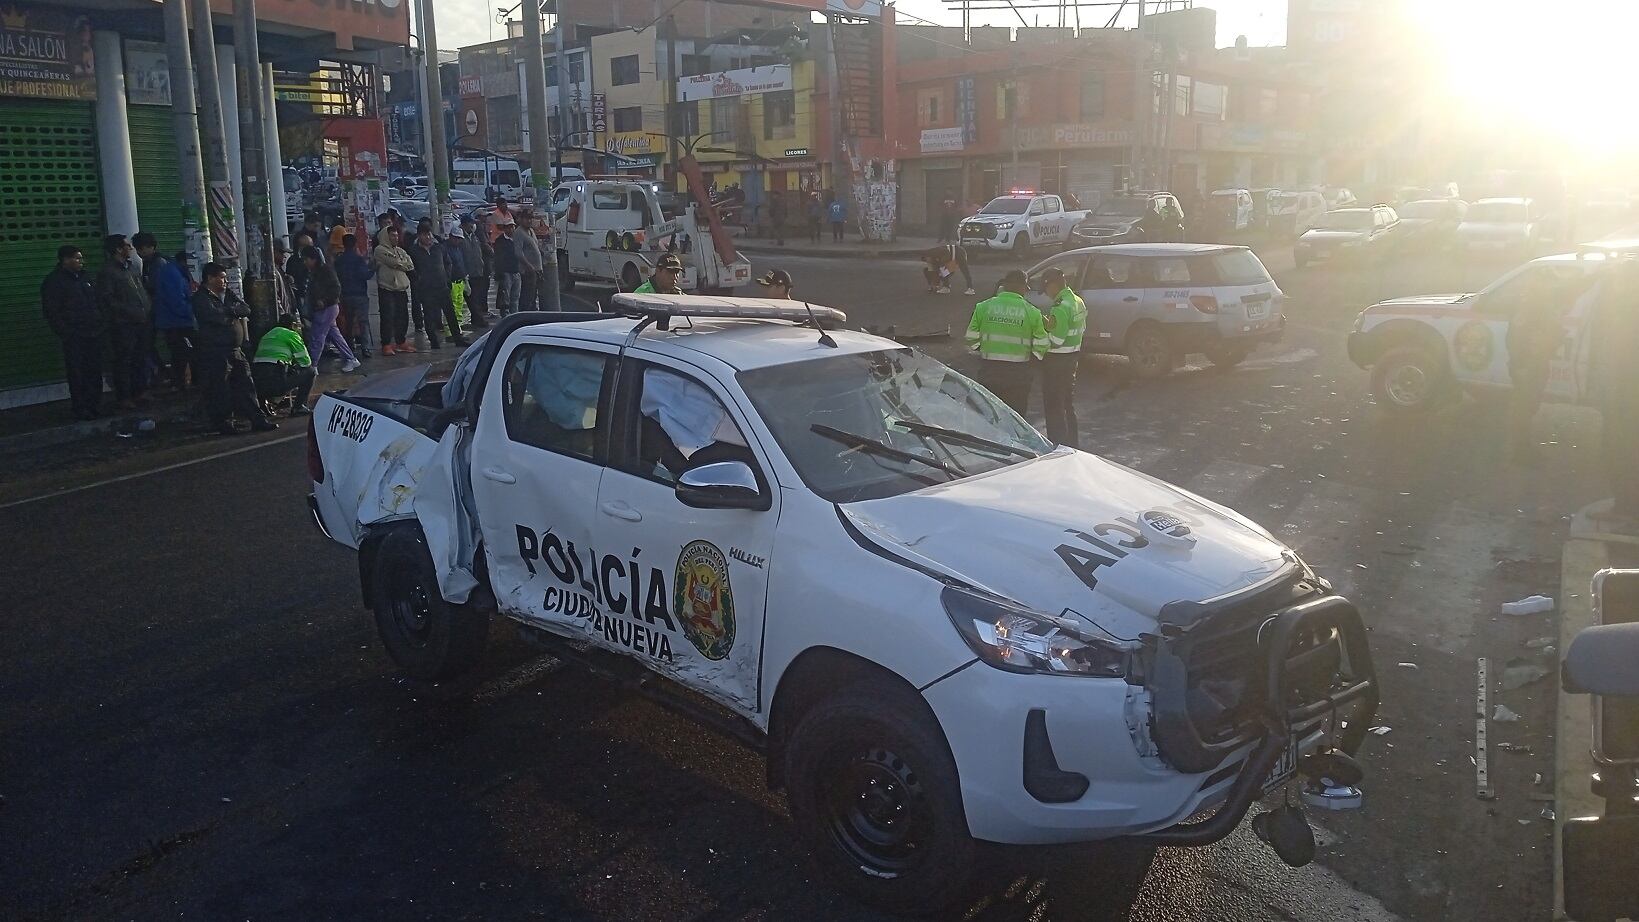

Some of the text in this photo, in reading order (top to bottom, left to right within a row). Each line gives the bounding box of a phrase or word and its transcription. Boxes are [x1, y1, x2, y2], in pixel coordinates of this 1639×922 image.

[19, 35, 67, 60] SALÓN
[16, 81, 81, 98] PROFESIONAL
[592, 94, 606, 132] TORTAS
[966, 78, 977, 145] DENTAL
[515, 523, 677, 632] POLICÍA
[702, 546, 728, 586] NACIONAL
[729, 546, 766, 570] HILUX
[603, 615, 673, 663] NUEVA
